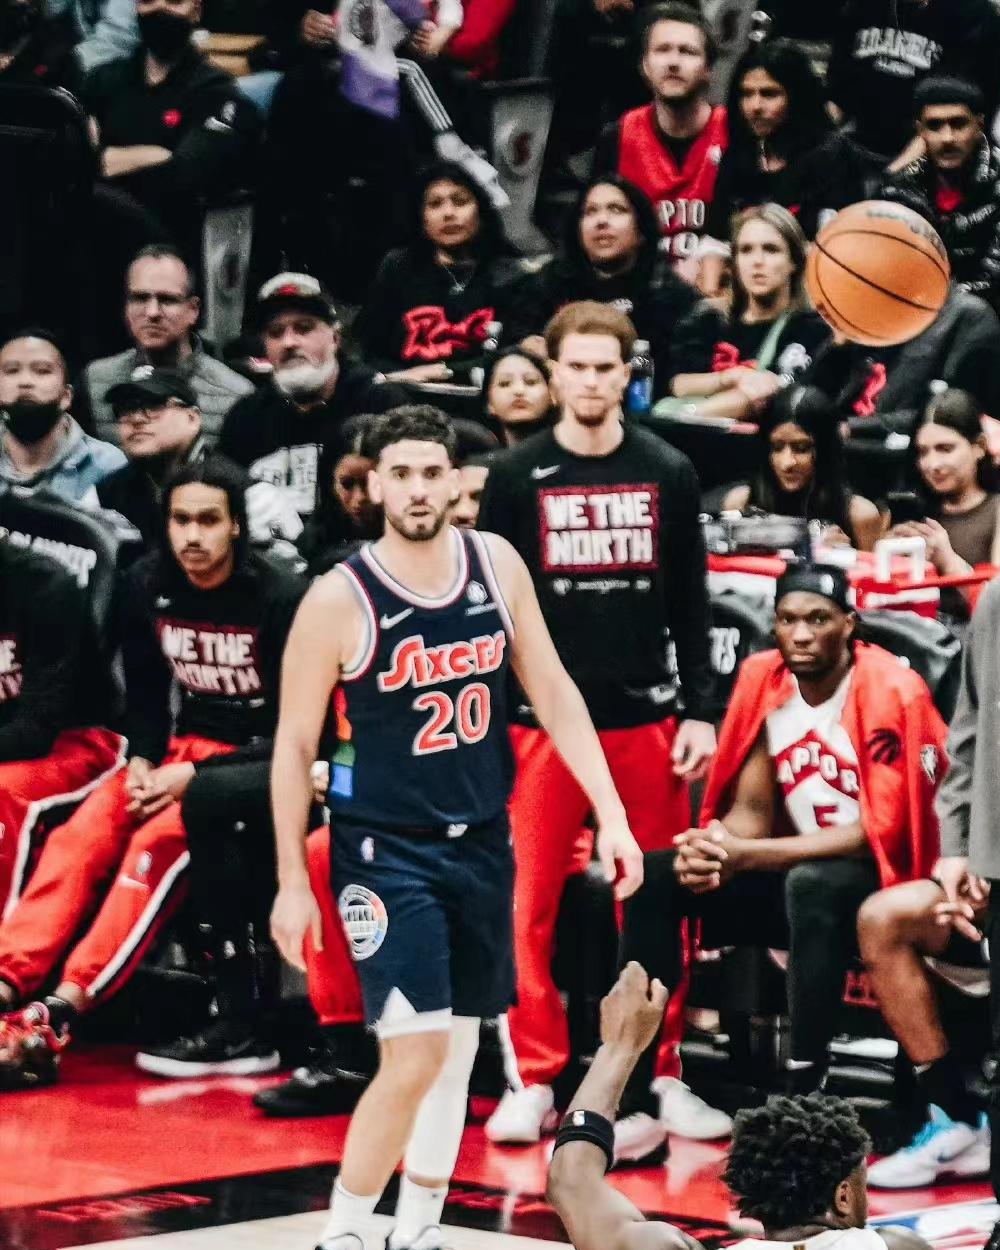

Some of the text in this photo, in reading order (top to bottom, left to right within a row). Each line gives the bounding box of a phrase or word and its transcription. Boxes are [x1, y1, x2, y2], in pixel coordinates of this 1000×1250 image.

[544, 491, 653, 530] WE THE
[546, 528, 653, 566] NORTH
[162, 624, 255, 667] WE THE
[376, 630, 506, 693] Sixers
[411, 682, 492, 756] 20
